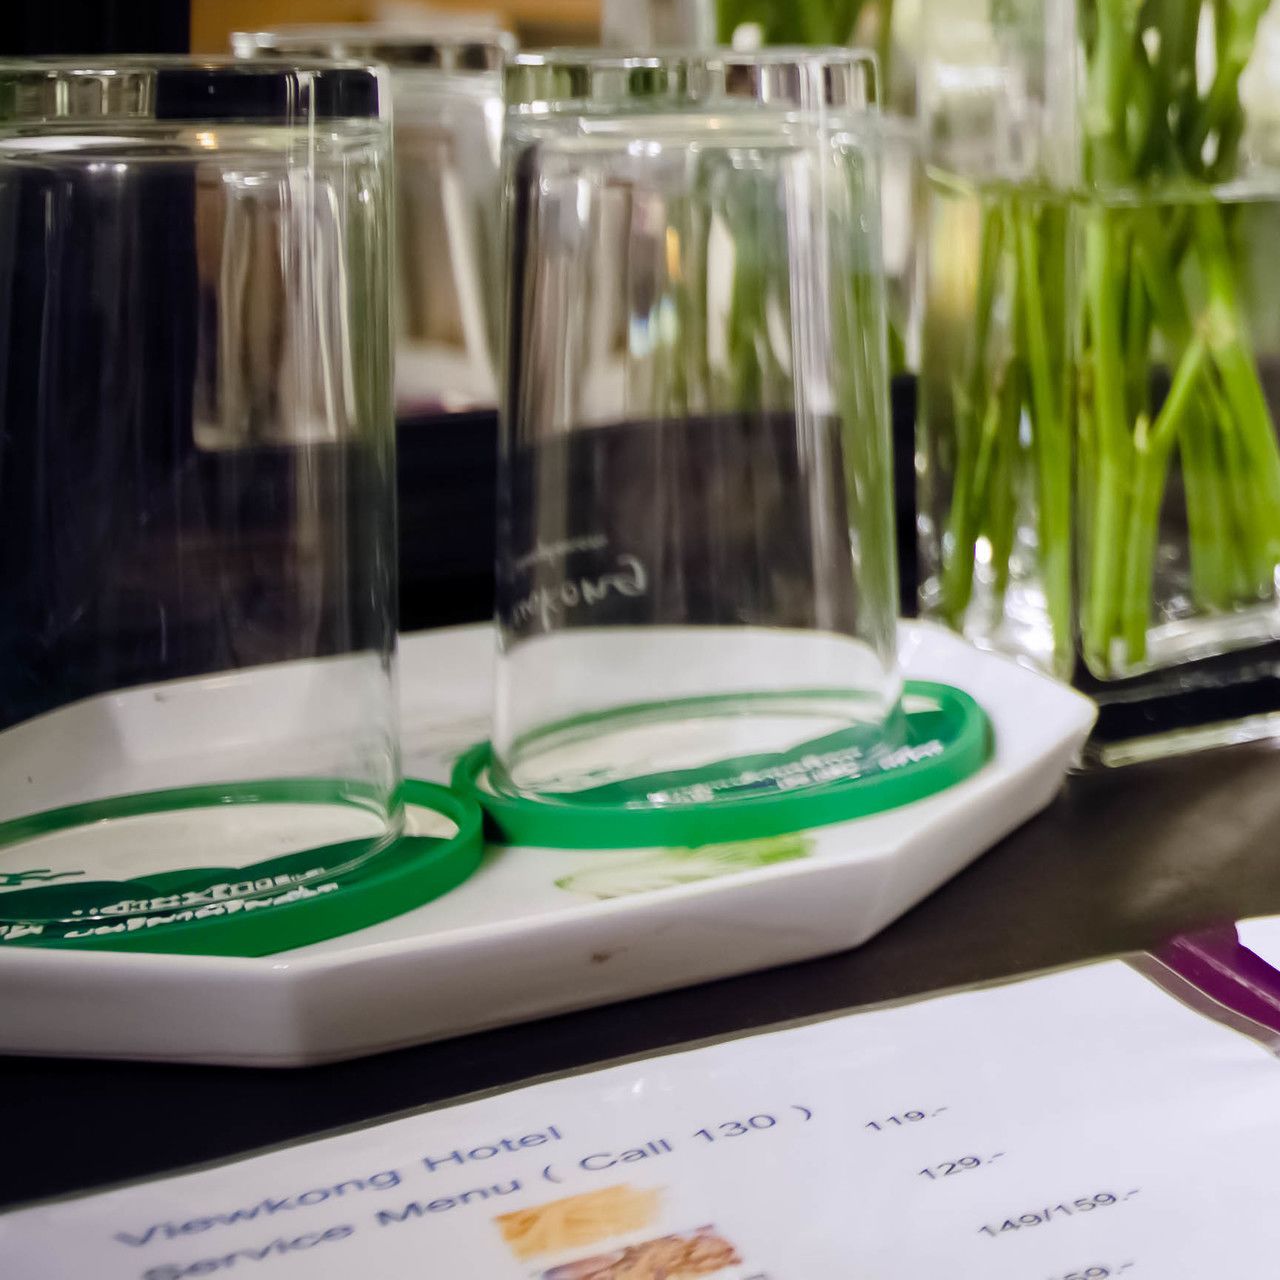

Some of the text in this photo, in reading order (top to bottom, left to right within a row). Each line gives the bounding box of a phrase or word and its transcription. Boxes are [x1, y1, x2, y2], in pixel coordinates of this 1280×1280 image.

[113, 1124, 563, 1247] Viewkong Hotel
[141, 1224, 355, 1280] Service
[374, 1178, 522, 1226] Menu
[579, 1137, 673, 1172] Call
[690, 1113, 778, 1145] 130
[918, 1151, 1007, 1181] 129.-
[977, 1187, 1141, 1238] 149/159.-
